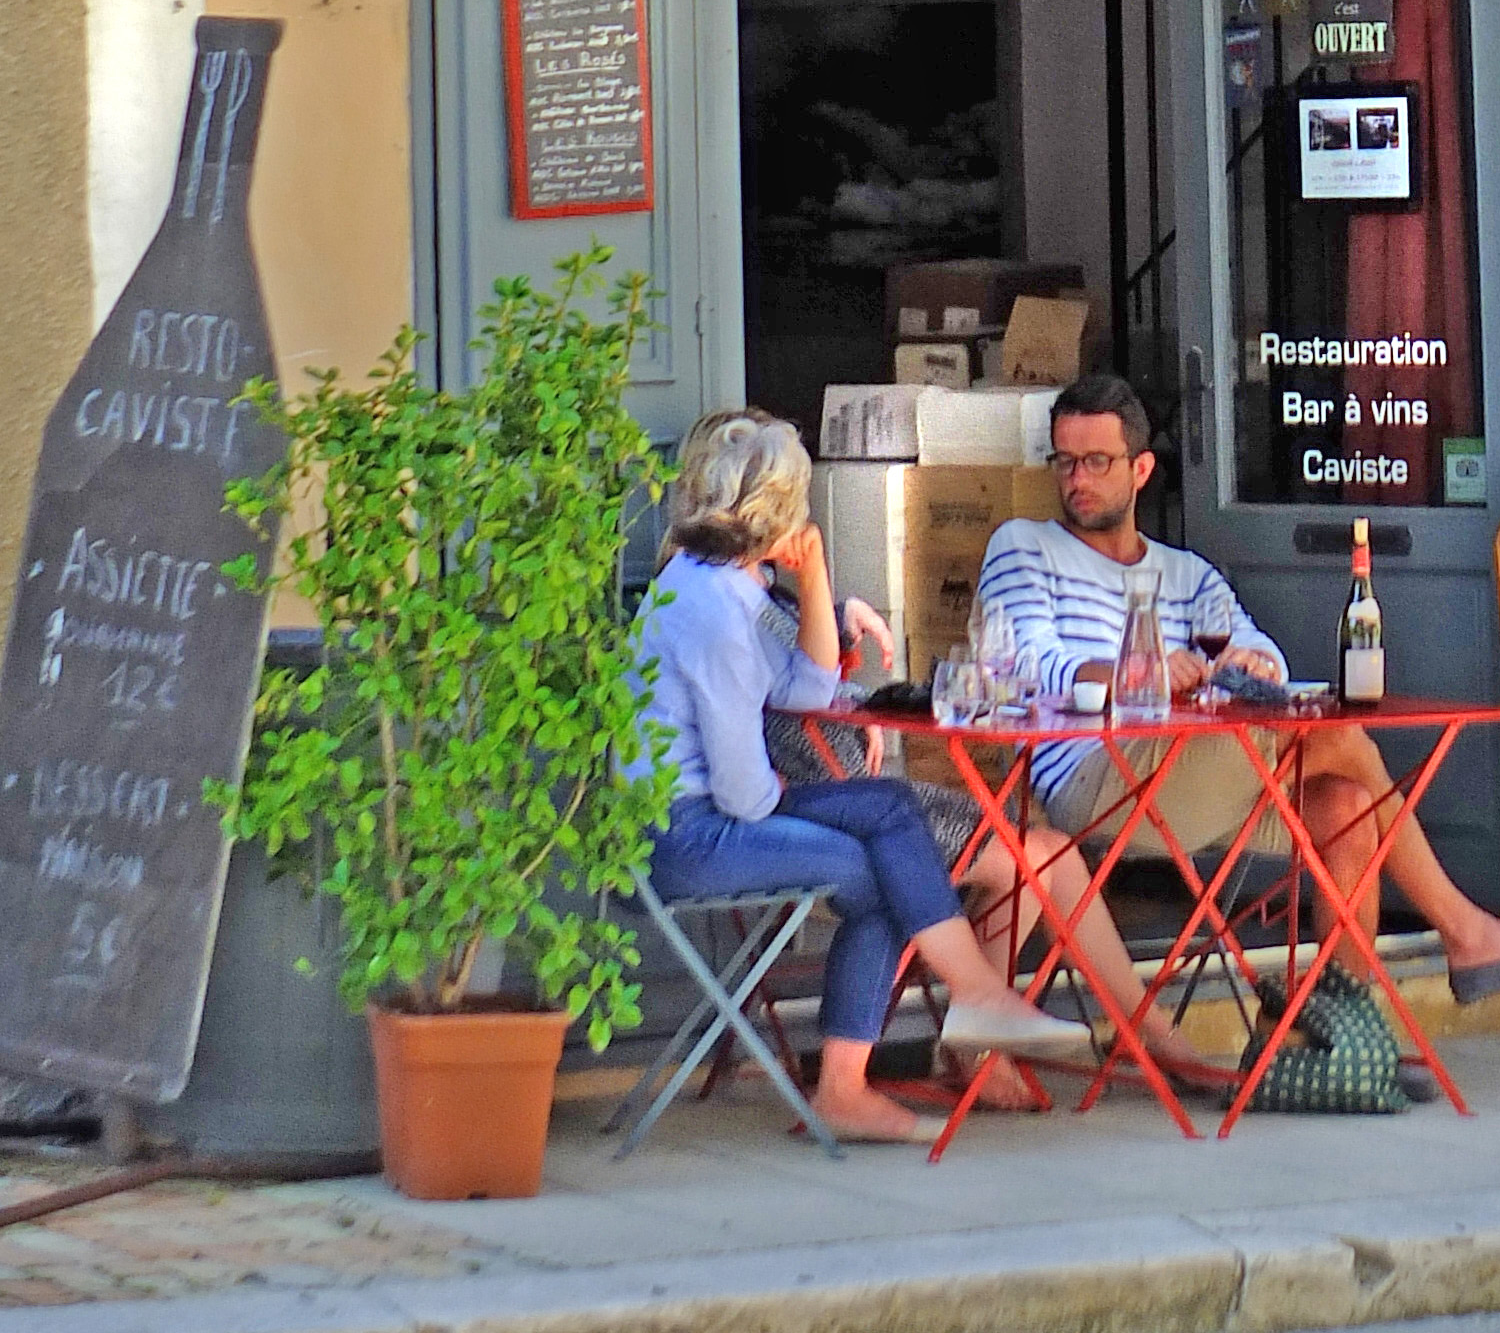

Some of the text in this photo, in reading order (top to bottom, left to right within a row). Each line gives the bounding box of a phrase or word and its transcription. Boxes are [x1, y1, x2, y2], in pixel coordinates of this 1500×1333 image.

[1313, 21, 1388, 53] OUVERT
[1259, 332, 1448, 367] Restauration
[1282, 390, 1429, 425] Bar à vins
[1301, 449, 1409, 484] Caviste
